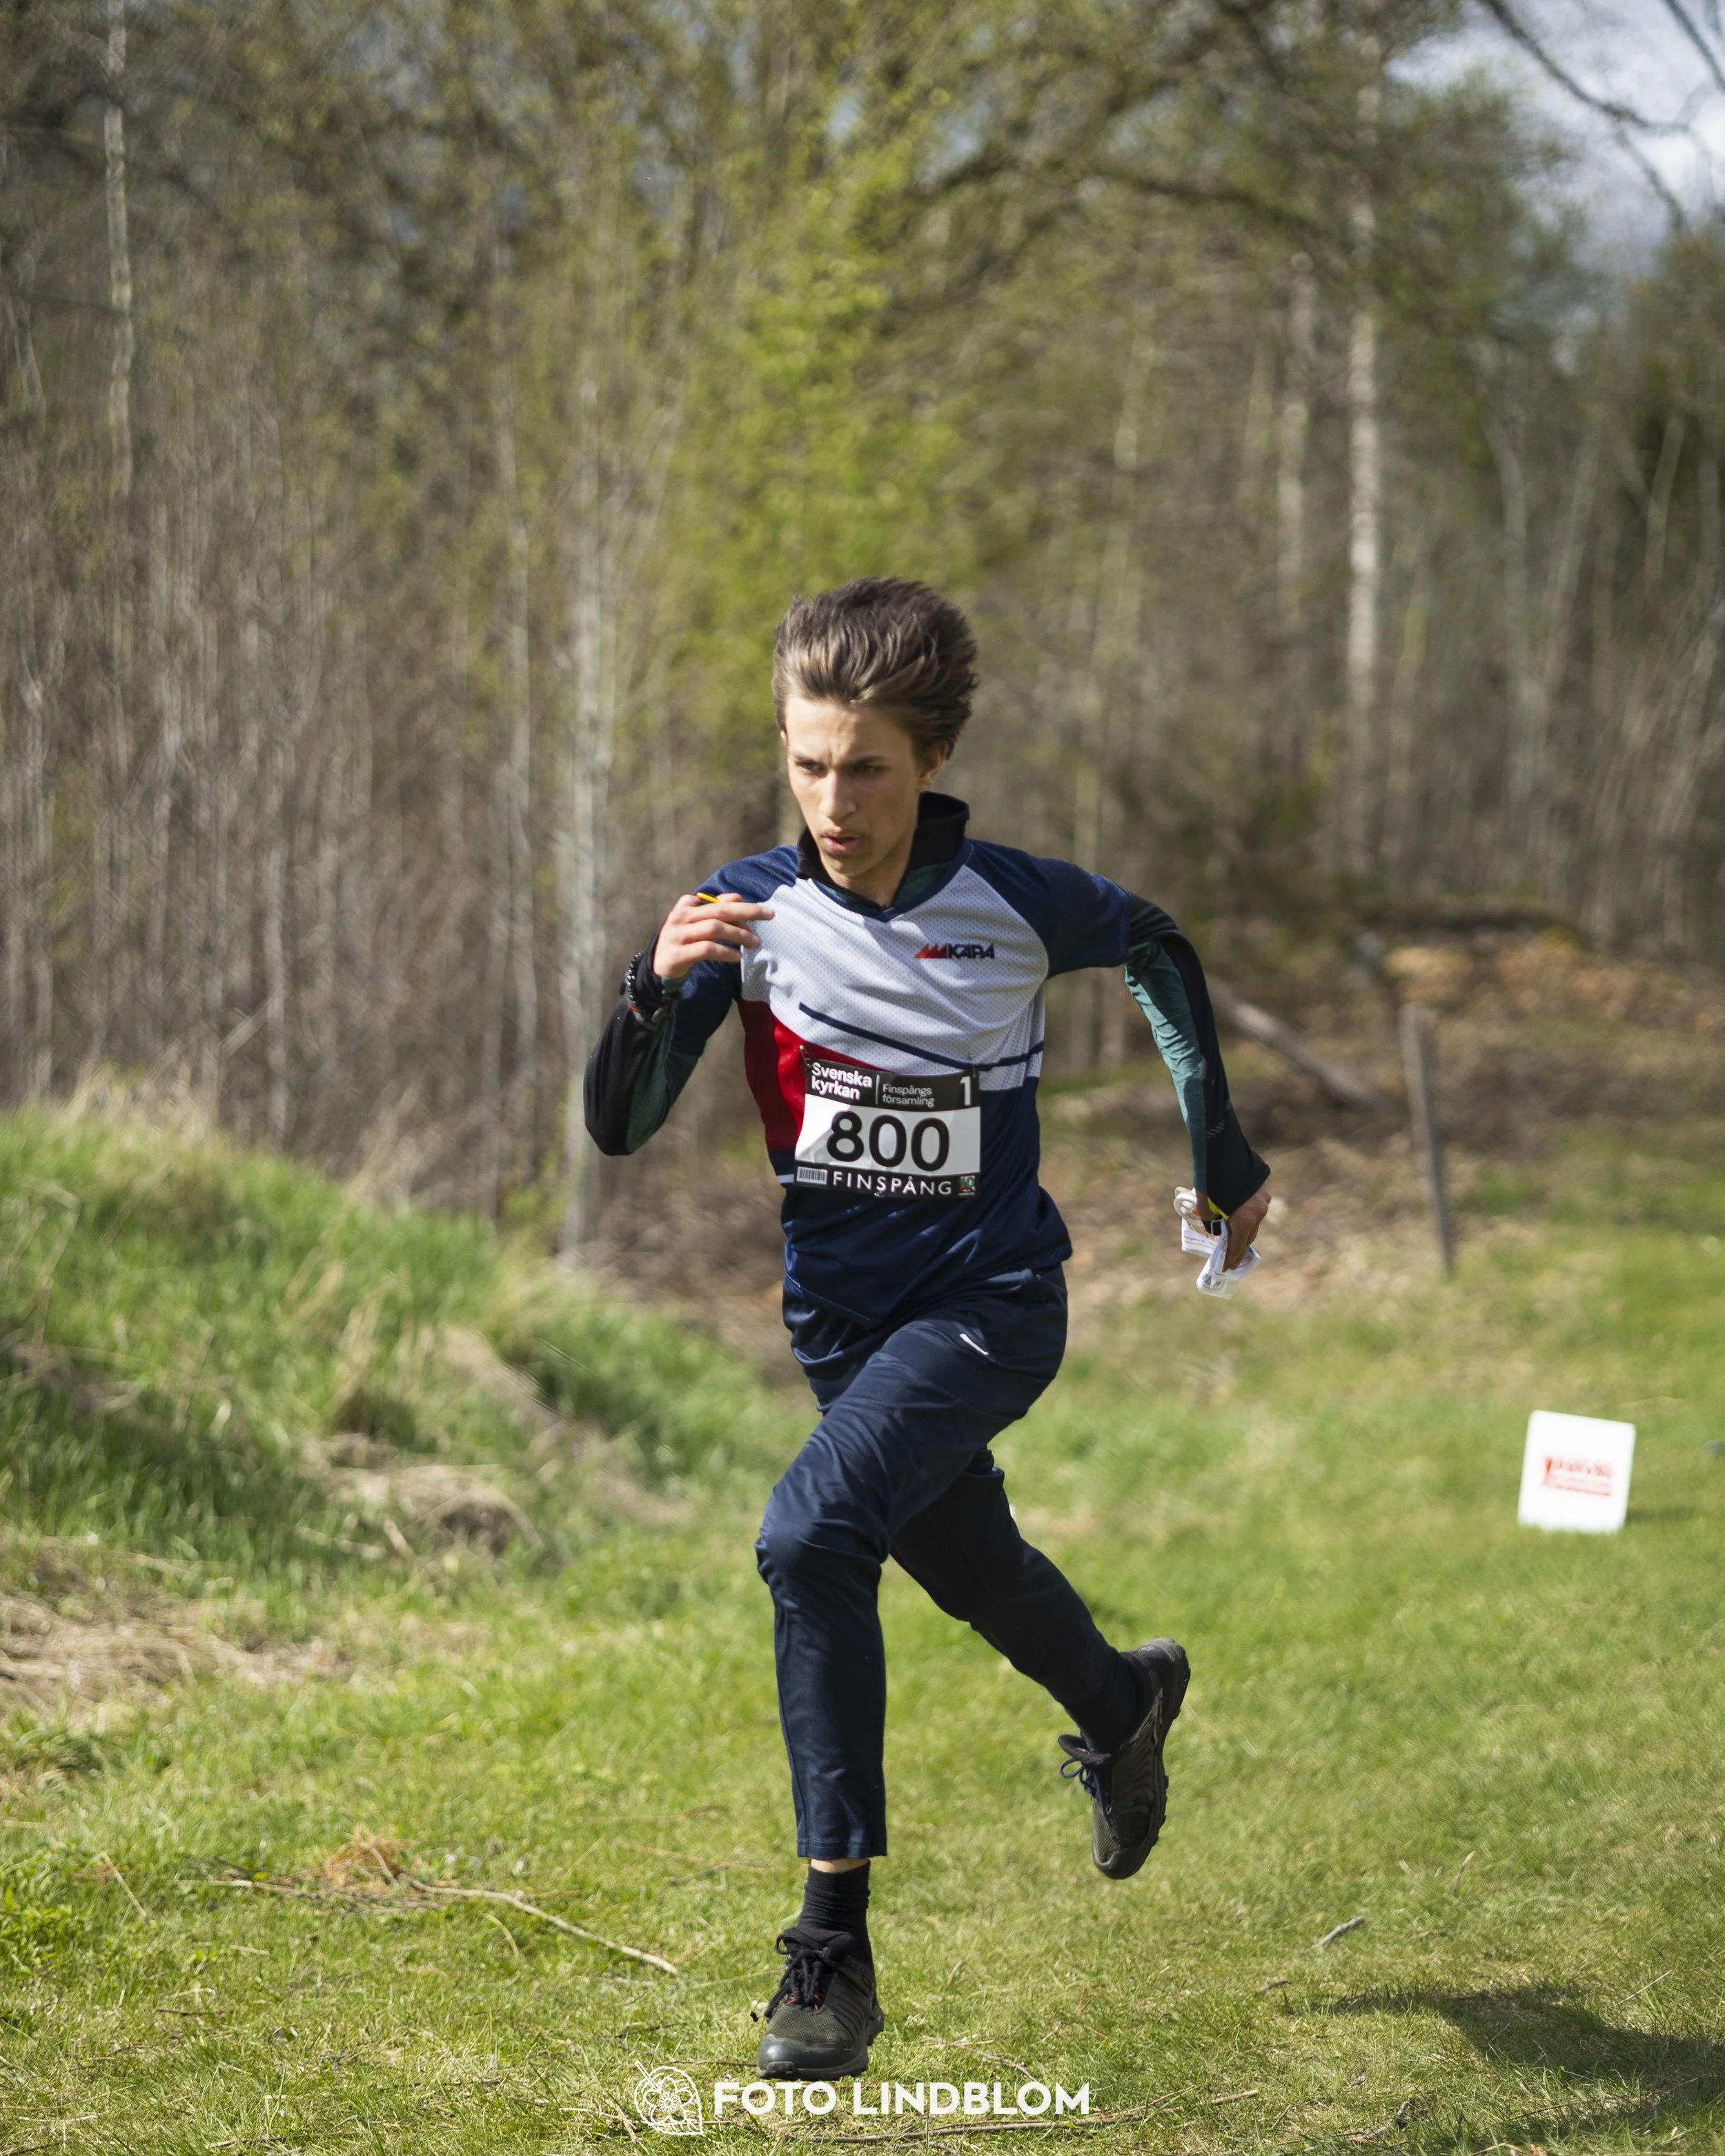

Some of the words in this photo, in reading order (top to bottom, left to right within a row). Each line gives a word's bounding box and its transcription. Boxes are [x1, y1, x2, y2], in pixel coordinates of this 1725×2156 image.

[811, 1062, 873, 1088] Svenska
[811, 1076, 860, 1100] kyrkan
[883, 1083, 932, 1096] Finspångs
[883, 1094, 934, 1107] församling
[960, 1076, 972, 1106] 1
[826, 1111, 949, 1172] 800
[833, 1171, 952, 1196] FINSPÅNG
